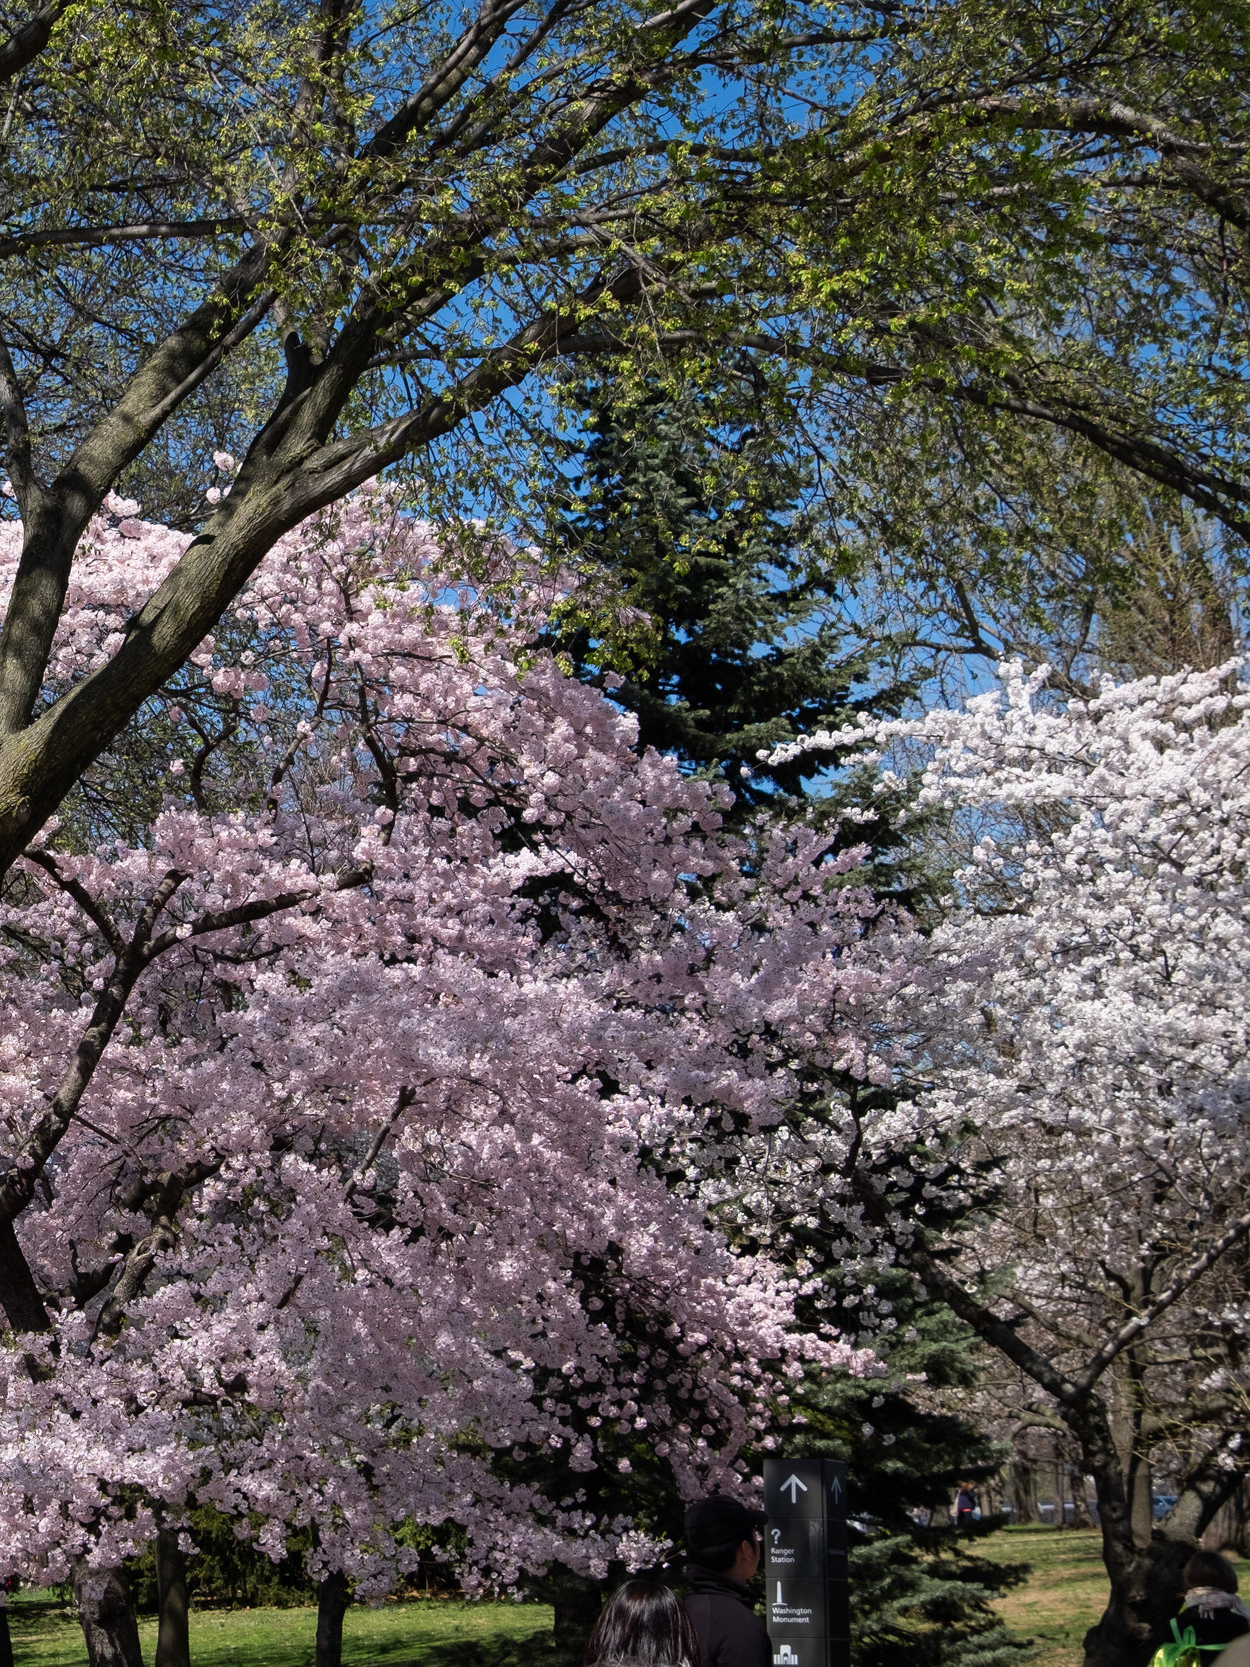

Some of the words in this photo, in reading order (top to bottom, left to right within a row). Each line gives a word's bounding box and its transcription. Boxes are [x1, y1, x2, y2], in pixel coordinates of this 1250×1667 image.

[770, 1547, 795, 1555] Ranger
[771, 1607, 813, 1616] Washington
[772, 1615, 810, 1623] Monument
